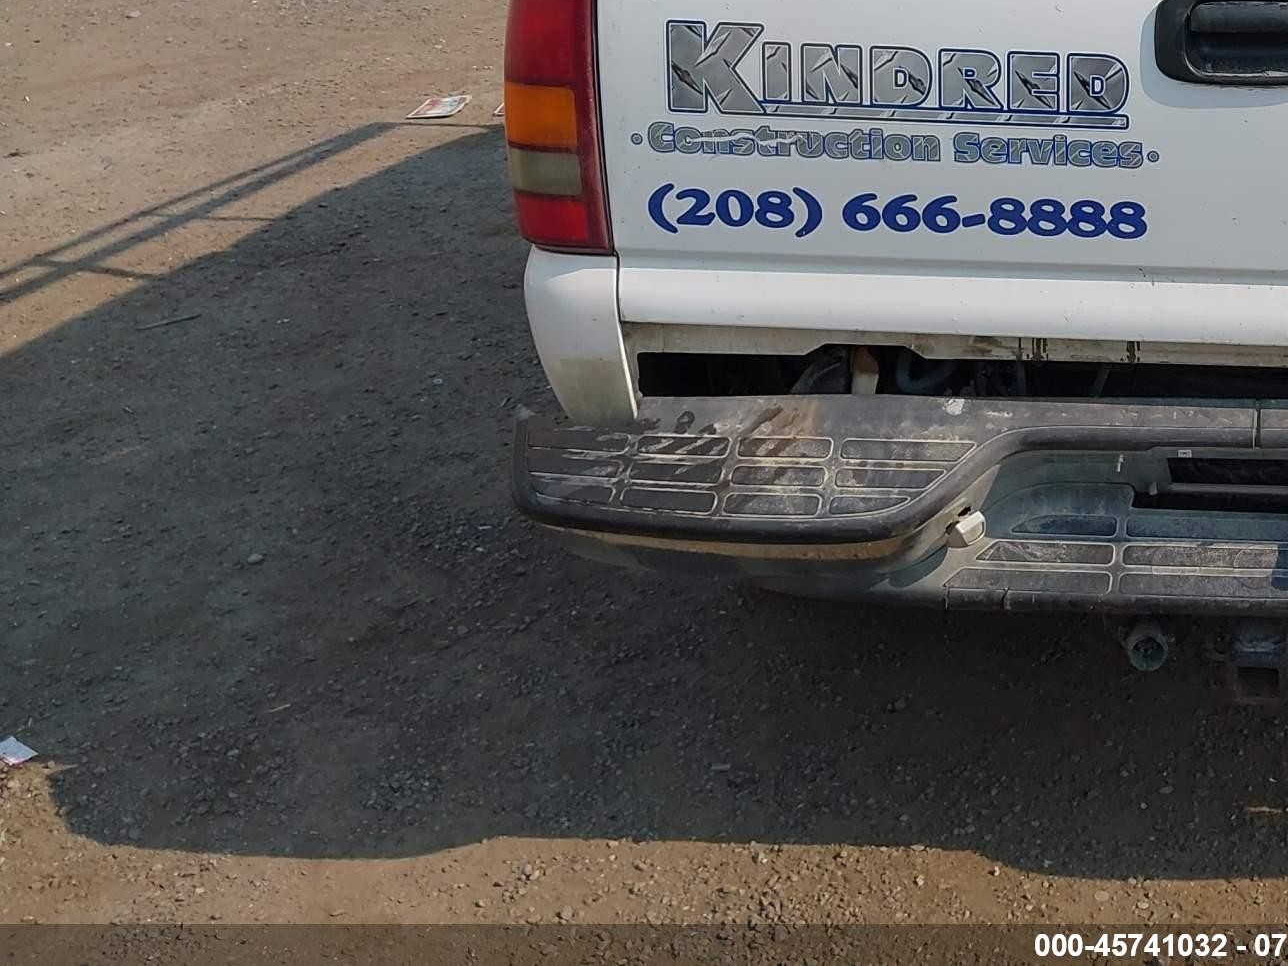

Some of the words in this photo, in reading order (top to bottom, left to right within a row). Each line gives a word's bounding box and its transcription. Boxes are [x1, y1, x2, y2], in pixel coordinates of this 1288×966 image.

[647, 121, 941, 163] Construction
[953, 130, 1145, 169] Services
[647, 183, 823, 238] (208)
[842, 192, 1148, 240] 666-8888
